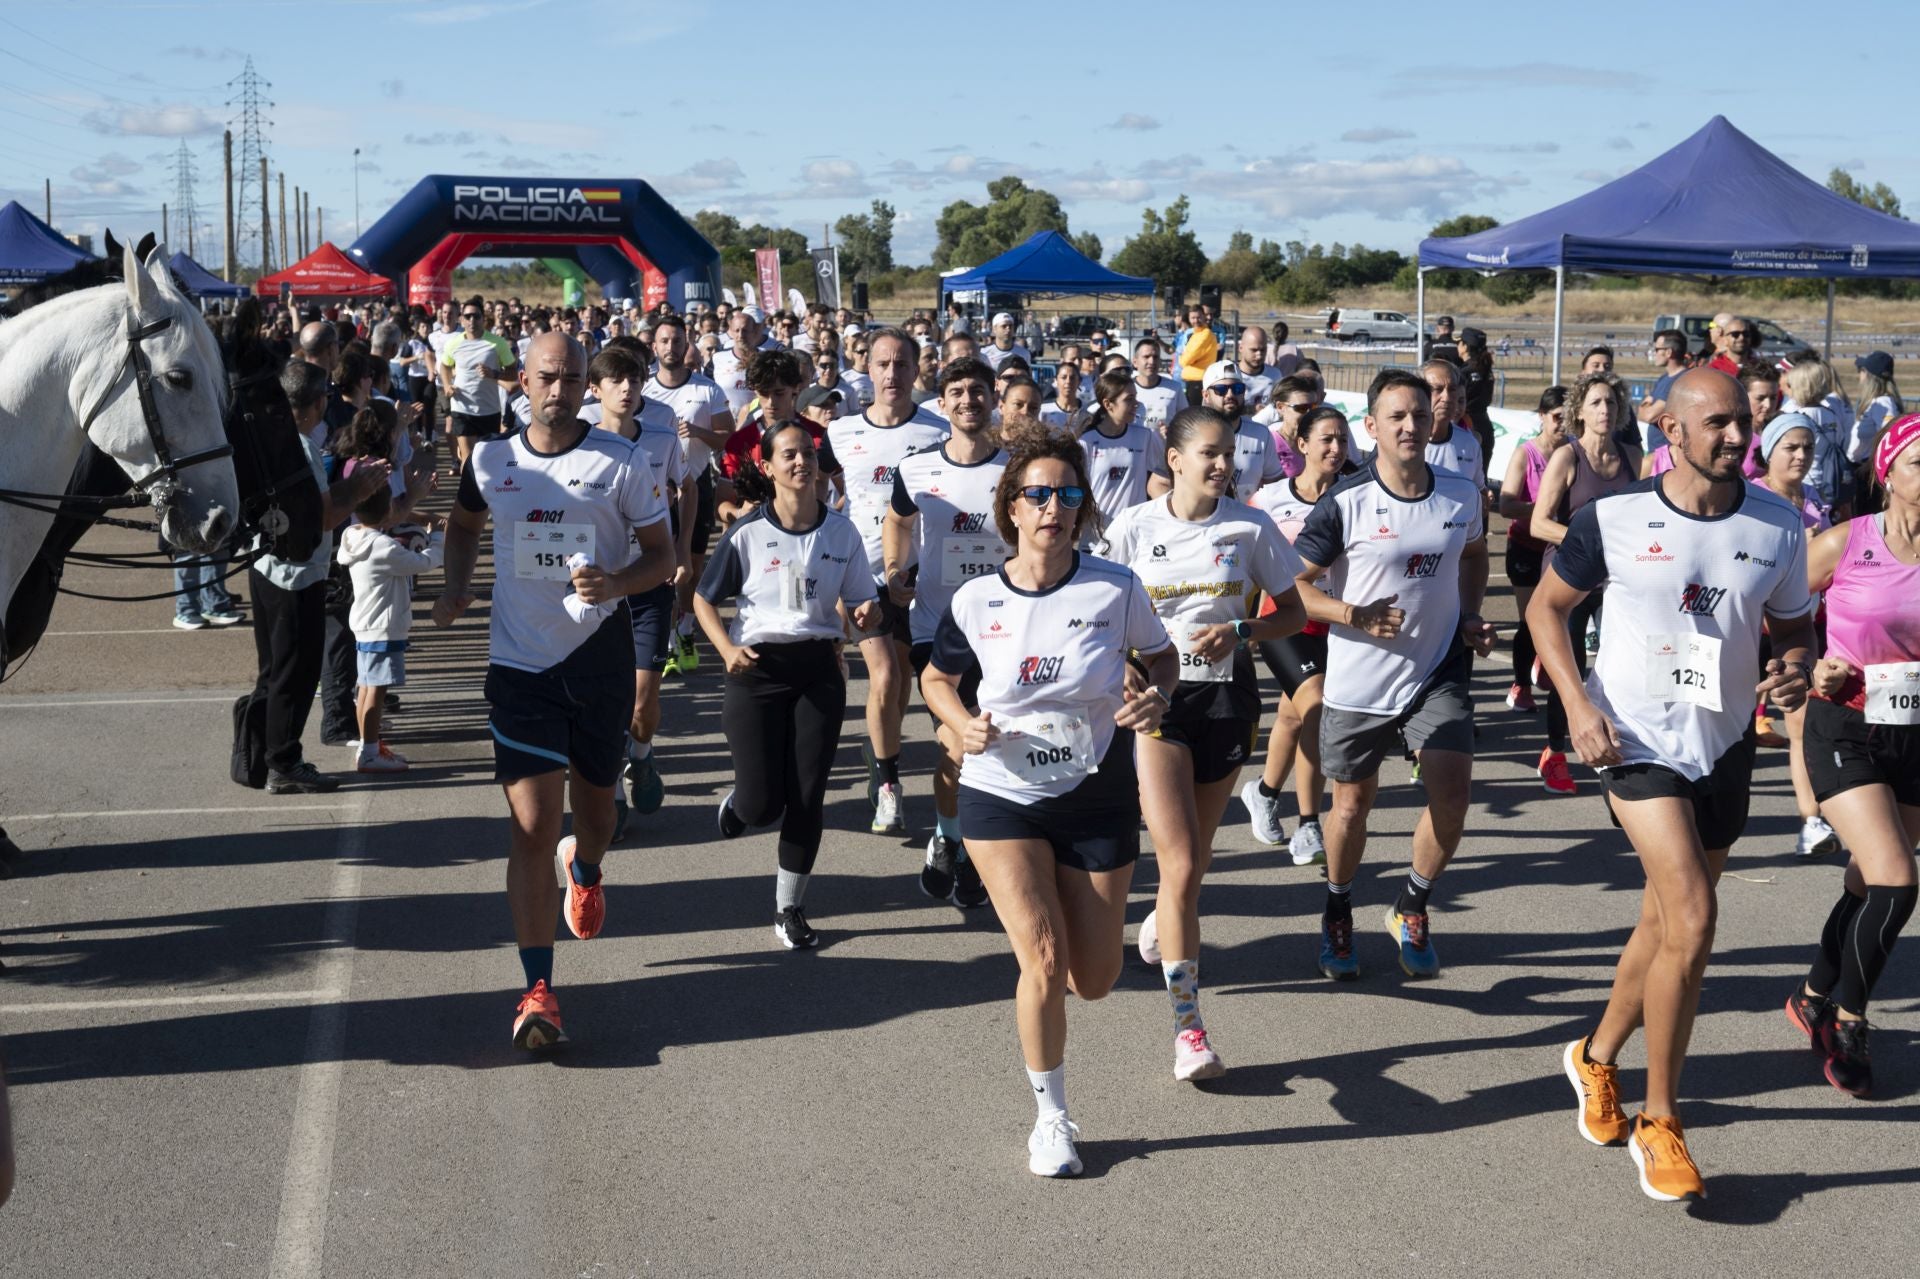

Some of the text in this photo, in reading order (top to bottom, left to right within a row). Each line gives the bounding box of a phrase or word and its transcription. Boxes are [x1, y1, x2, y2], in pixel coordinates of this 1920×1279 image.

[454, 185, 587, 203] POLICIA
[454, 204, 621, 222] NACIONAL
[1731, 249, 1795, 261] Ayuntamiento
[684, 282, 710, 299] RUTA
[584, 481, 606, 490] mupol
[535, 553, 573, 567] 151
[1752, 557, 1777, 568] mupol
[1086, 619, 1110, 629] mupol
[979, 631, 1012, 640] Santander
[1671, 668, 1707, 690] 1272
[1026, 746, 1073, 768] 1008
